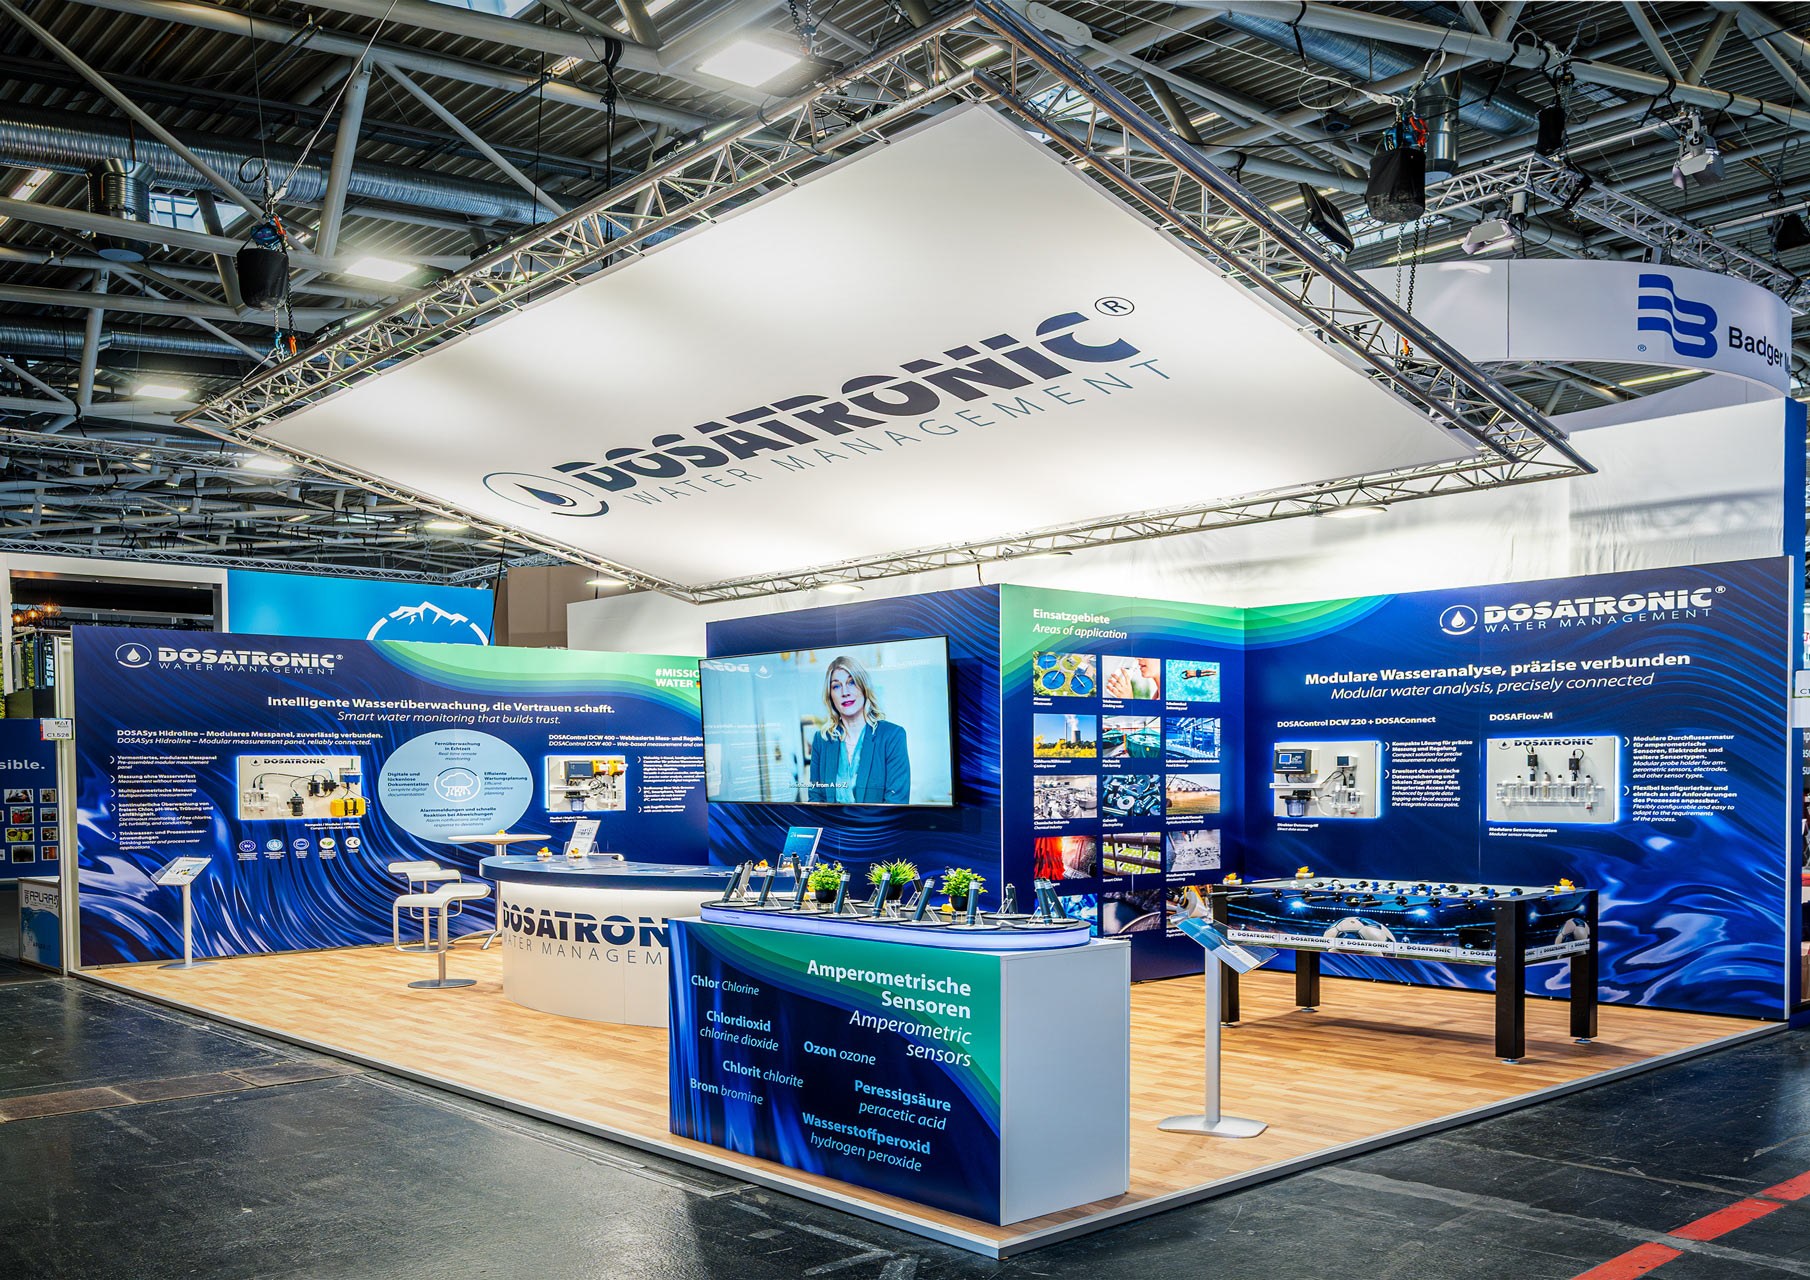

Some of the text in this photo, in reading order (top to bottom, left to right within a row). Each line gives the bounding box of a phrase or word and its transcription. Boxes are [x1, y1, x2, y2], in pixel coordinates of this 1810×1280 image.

[1729, 326, 1783, 367] Badger
[624, 358, 1170, 506] WATER MANAGEMENT
[1033, 608, 1110, 625] Einsatzgebiete
[1485, 607, 1712, 633] WATER MANAGEMENT
[1032, 623, 1128, 640] Areas of application
[159, 662, 335, 675] WATER MANAGEMENT
[1305, 653, 1690, 685] Modulare Wasseranalyse, präzise verbunden
[655, 678, 694, 688] WATER
[1331, 672, 1655, 700] Modular water analysis, precisely connected
[268, 696, 616, 714] Intelligente Wasserüberwachung, die Vertrauen schafft.
[1489, 711, 1553, 721] DOSAFlow-M
[338, 711, 561, 726] Smart water monitoring that builds trust.
[1277, 719, 1328, 729] DOSAControl
[1329, 719, 1350, 727] DCW
[1351, 718, 1367, 726] 220
[1375, 716, 1437, 725] DOSAConnect
[206, 731, 250, 739] Modulares
[296, 732, 339, 742] zuverlässig
[232, 738, 283, 746] measurement
[307, 738, 333, 747] reliably
[1514, 738, 1594, 747] DOSATRONIC
[0, 759, 45, 771] sible.
[691, 974, 760, 996] Chlor Chlorine
[807, 959, 972, 997] Amperometrische
[881, 990, 972, 1019] Sensoren
[706, 1010, 771, 1032] Chlordioxid
[849, 1009, 973, 1046] Amperometric
[699, 1026, 779, 1052] chlorine dioxide
[803, 1040, 876, 1065] Ozon ozone
[906, 1043, 972, 1068] sensors
[722, 1060, 804, 1088] Chlorit chlorite
[690, 1077, 763, 1105] Brom bromine
[854, 1079, 951, 1112] Peressigsäure
[858, 1102, 947, 1131] peracetic acid
[802, 1111, 931, 1156] Wasserstoffperoxid
[810, 1131, 922, 1173] hydrogen peroxide
